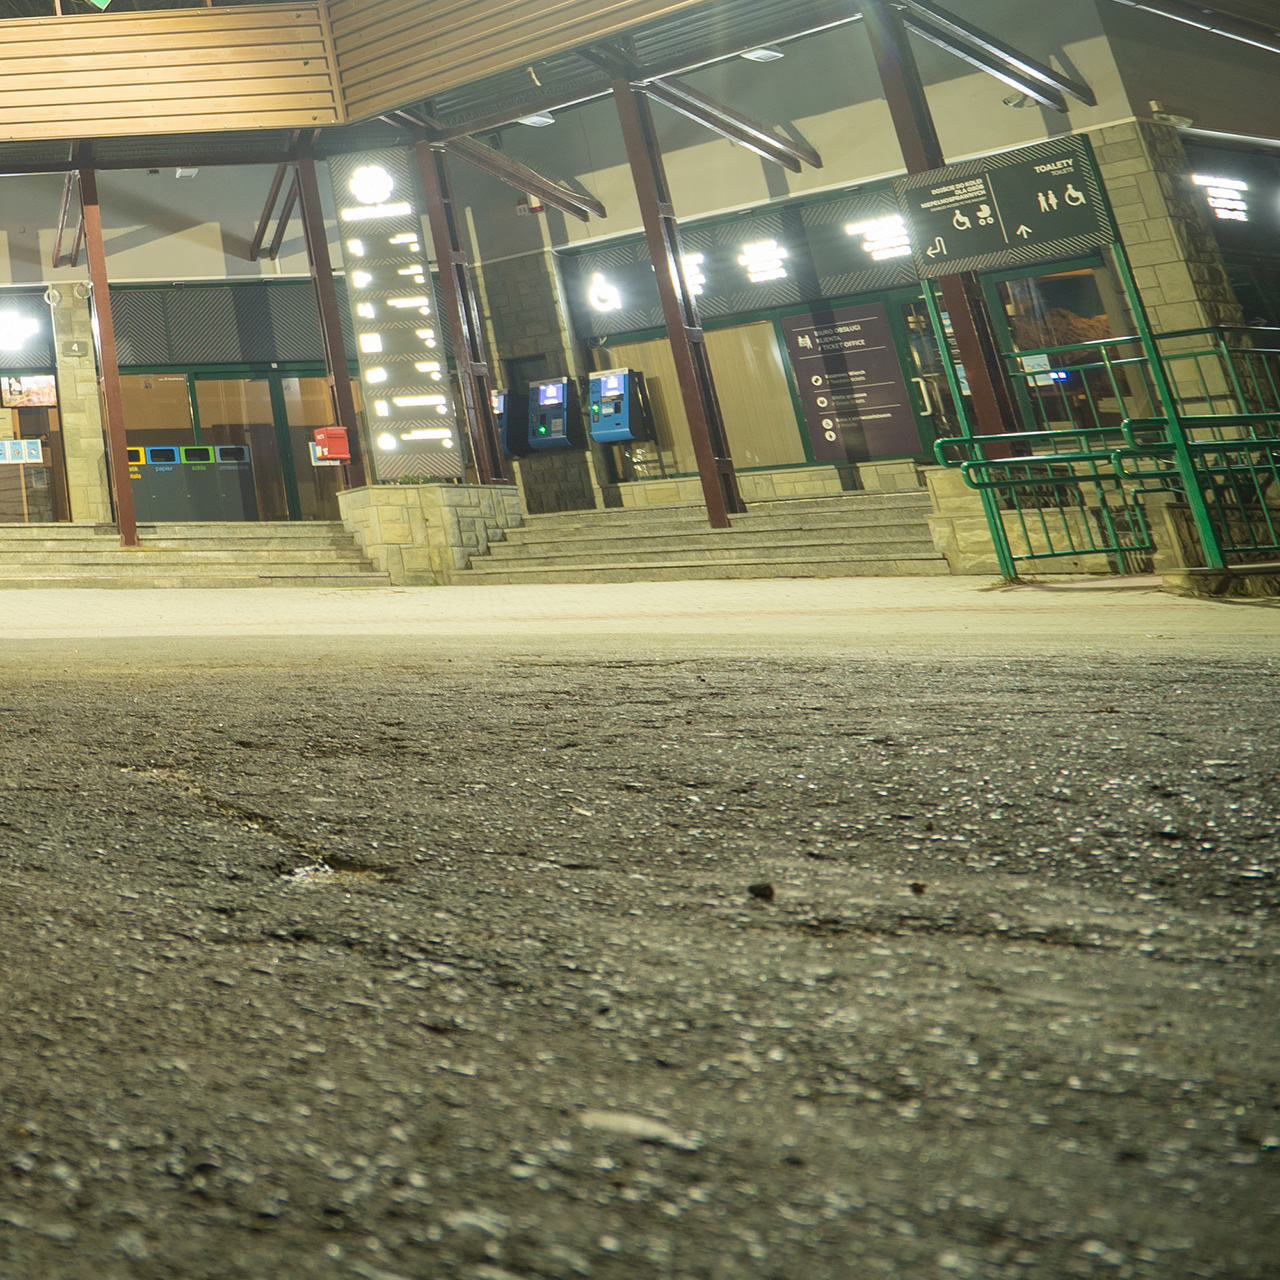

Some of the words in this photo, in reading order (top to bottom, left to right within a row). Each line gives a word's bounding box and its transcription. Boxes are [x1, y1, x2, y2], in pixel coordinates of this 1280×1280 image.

[1034, 158, 1074, 173] TOALETY
[956, 182, 965, 190] DO
[965, 178, 983, 188] KOLEI
[968, 184, 985, 193] OSÓB
[814, 329, 833, 337] BIURO
[834, 324, 861, 334] OBSŁUGI
[816, 336, 842, 344] KLIENTA
[823, 342, 843, 351] TICKET
[843, 339, 866, 348] OFFICE
[71, 343, 79, 352] 4
